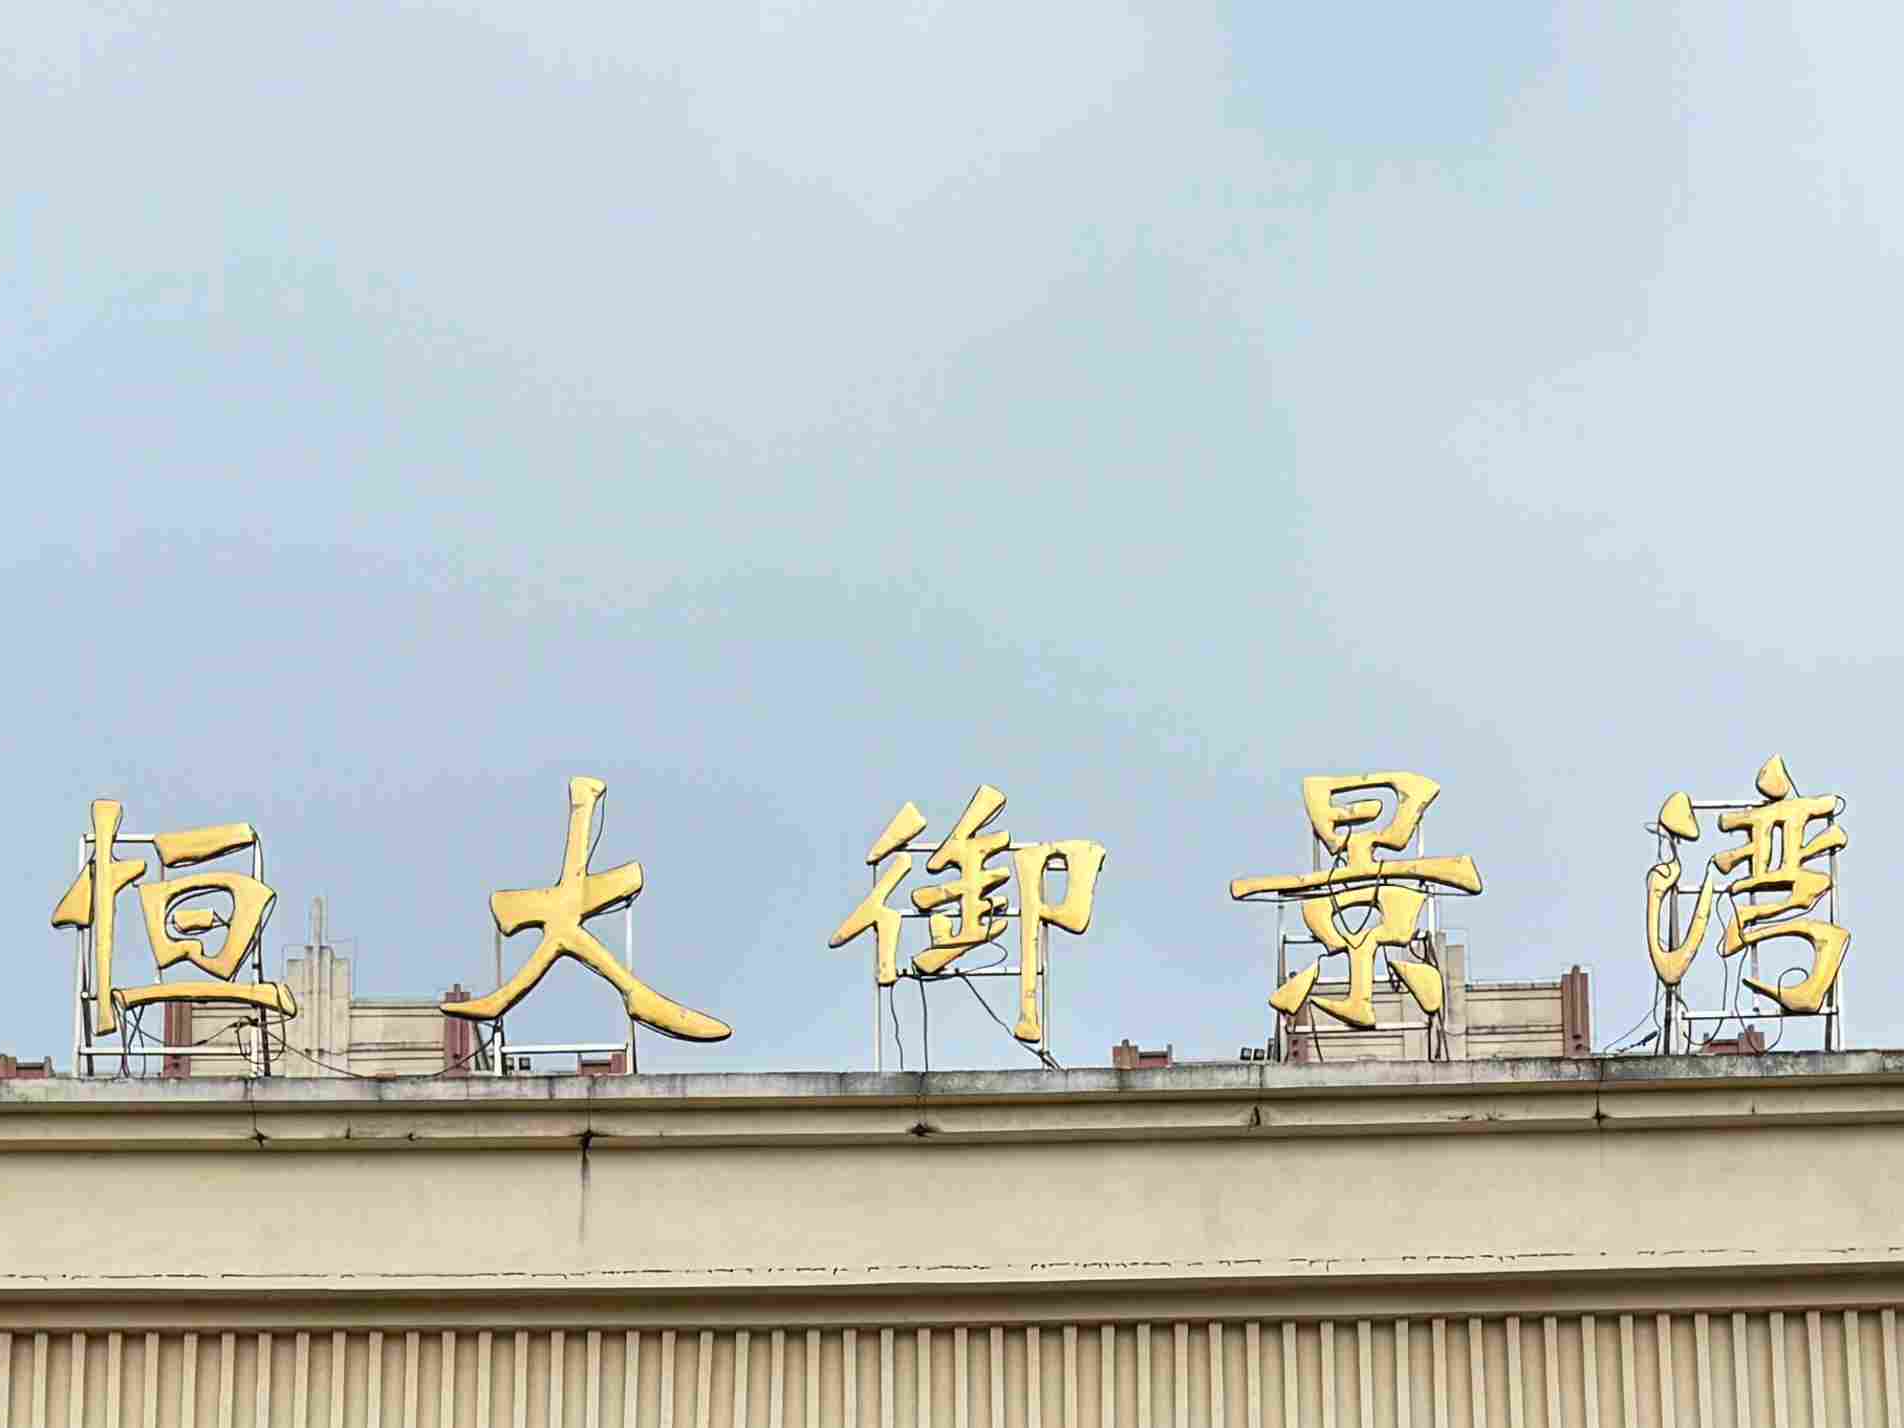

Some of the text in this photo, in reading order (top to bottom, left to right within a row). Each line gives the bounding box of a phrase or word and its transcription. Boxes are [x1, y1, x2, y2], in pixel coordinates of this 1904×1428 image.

[53, 756, 1852, 1042] 恒大御景湾
